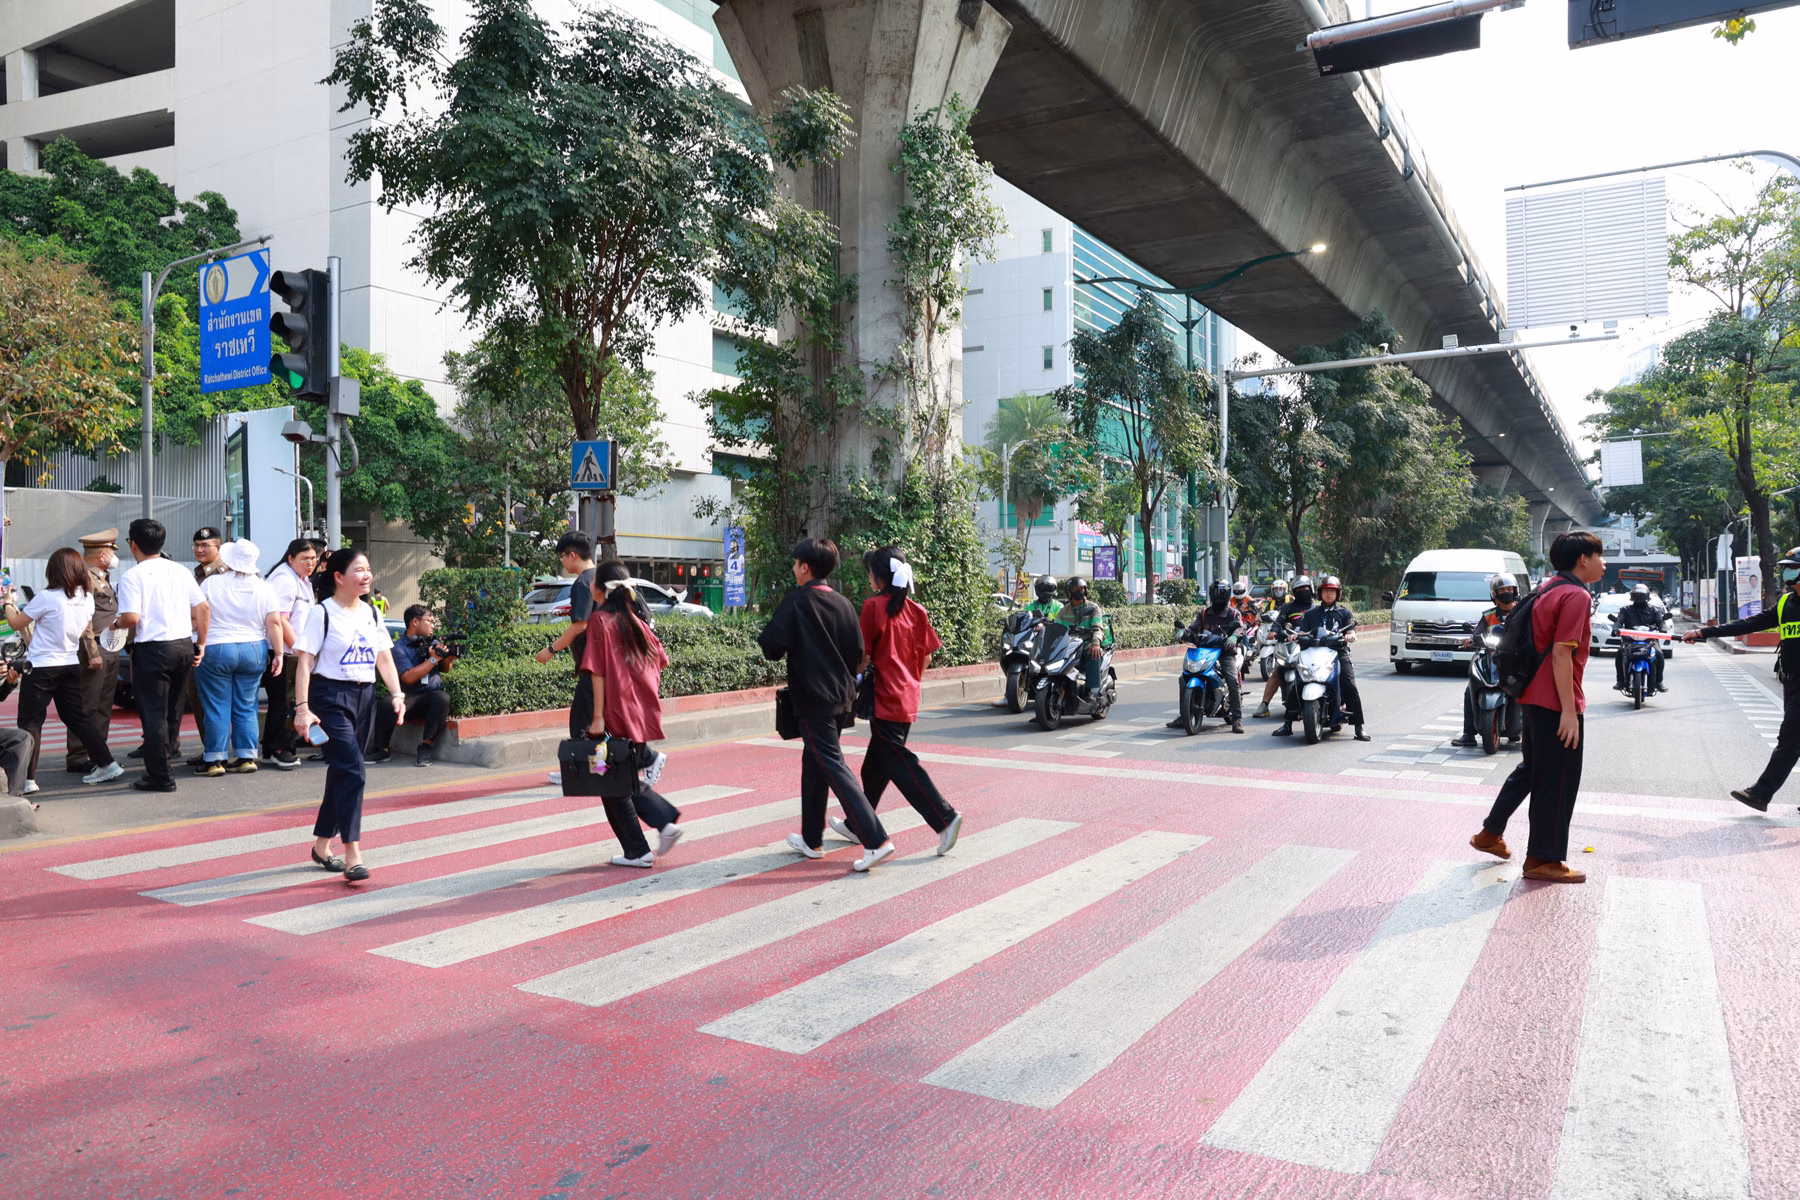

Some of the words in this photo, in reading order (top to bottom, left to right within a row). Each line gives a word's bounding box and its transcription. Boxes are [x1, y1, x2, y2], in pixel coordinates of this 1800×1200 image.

[207, 308, 262, 332] สำนักงานเขต
[214, 328, 255, 359] ราชเทวี
[233, 368, 251, 380] District
[251, 365, 268, 377] Office
[730, 561, 738, 571] 4
